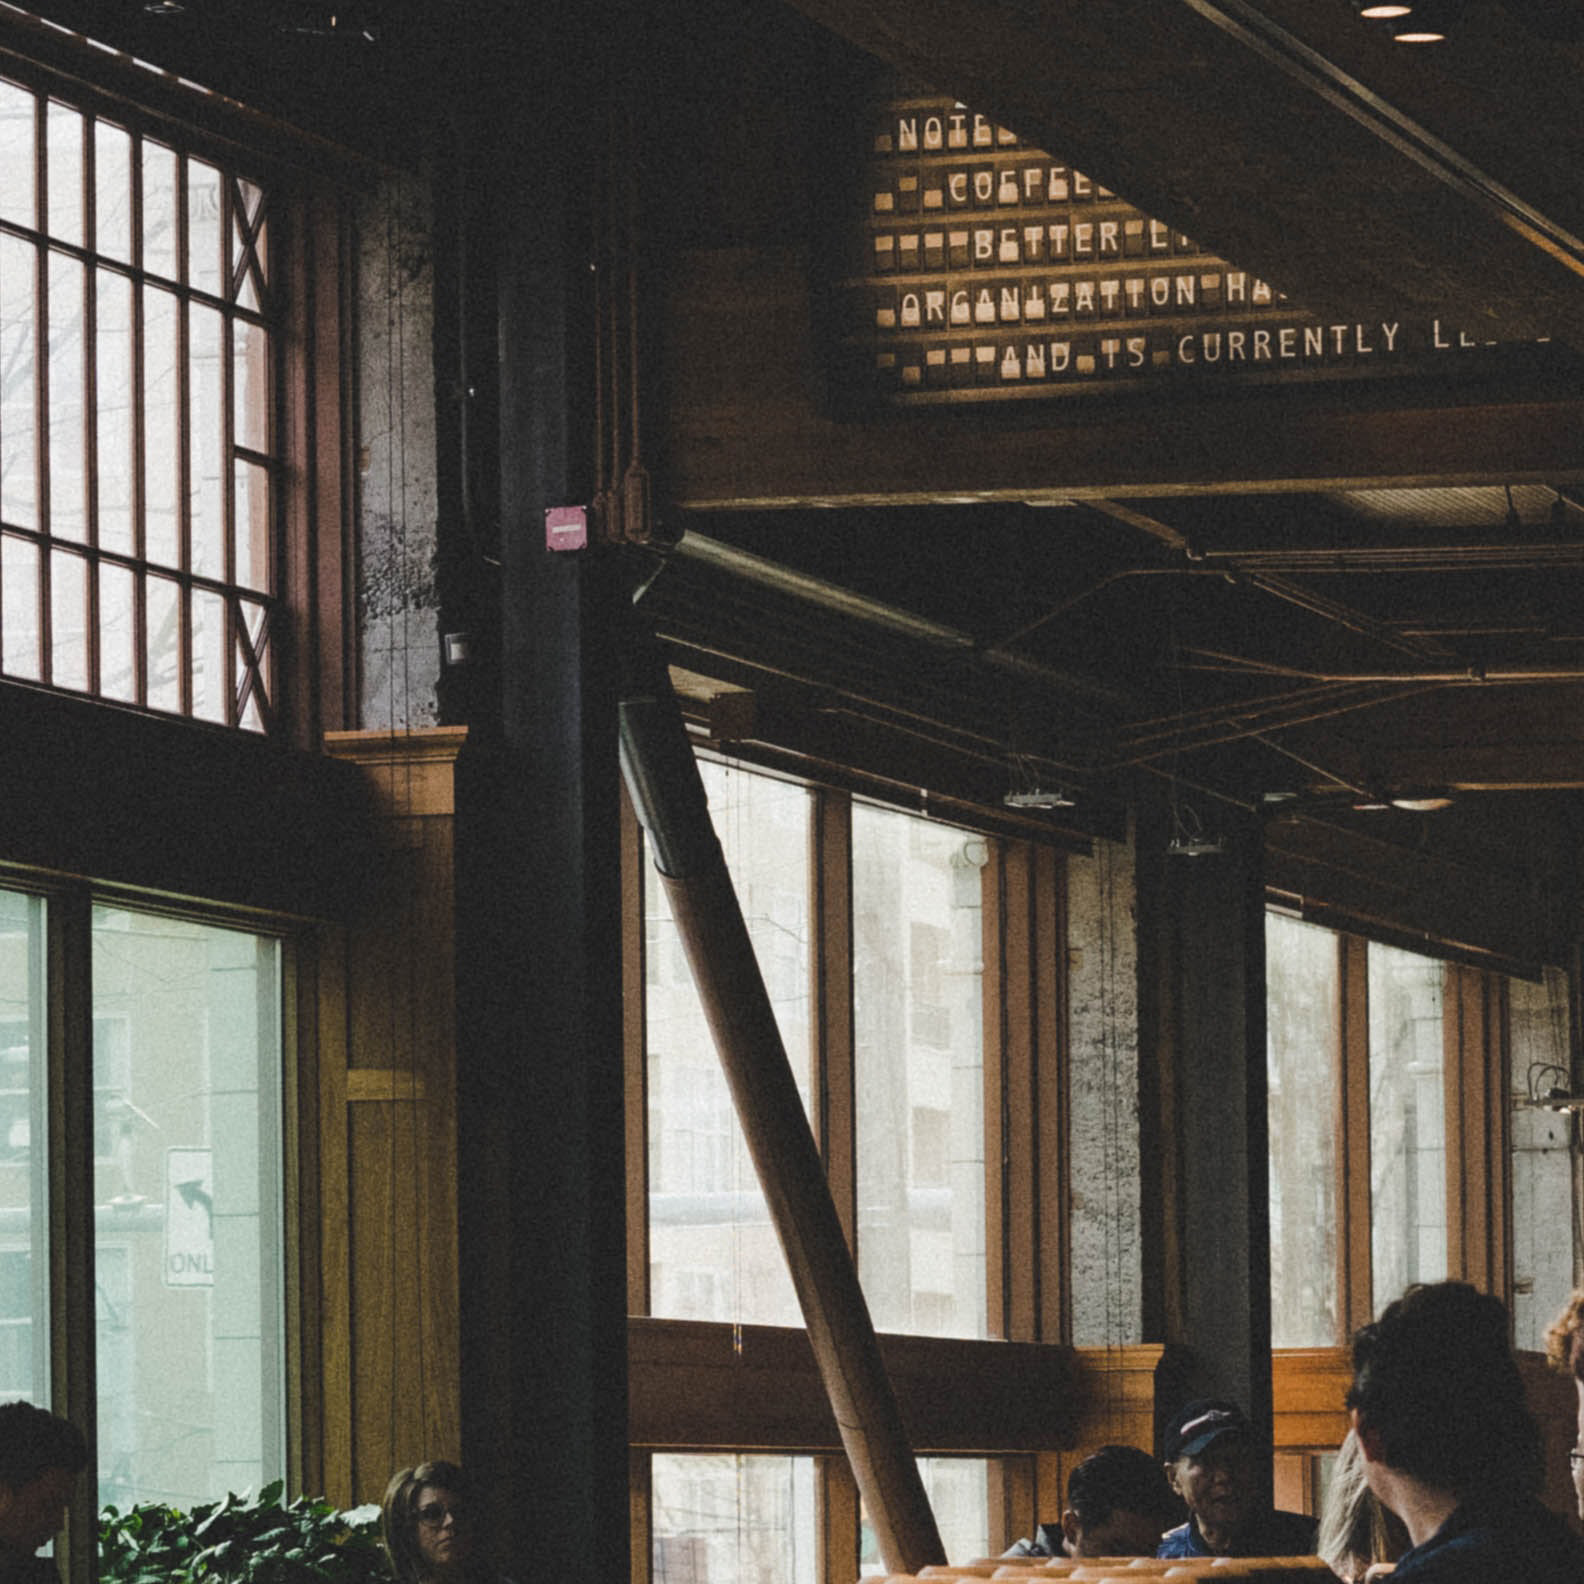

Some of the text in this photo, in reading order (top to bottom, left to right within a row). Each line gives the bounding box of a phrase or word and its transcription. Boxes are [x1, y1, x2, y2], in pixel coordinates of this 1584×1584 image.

[950, 167, 1092, 202] COFFEE
[975, 221, 1118, 260] BETTER
[902, 271, 1288, 323] ORGANIZATION HA
[1001, 342, 1070, 377] AND
[1104, 337, 1145, 368] IS
[1178, 322, 1399, 363] CURRENTLY
[170, 1253, 214, 1273] ONL
